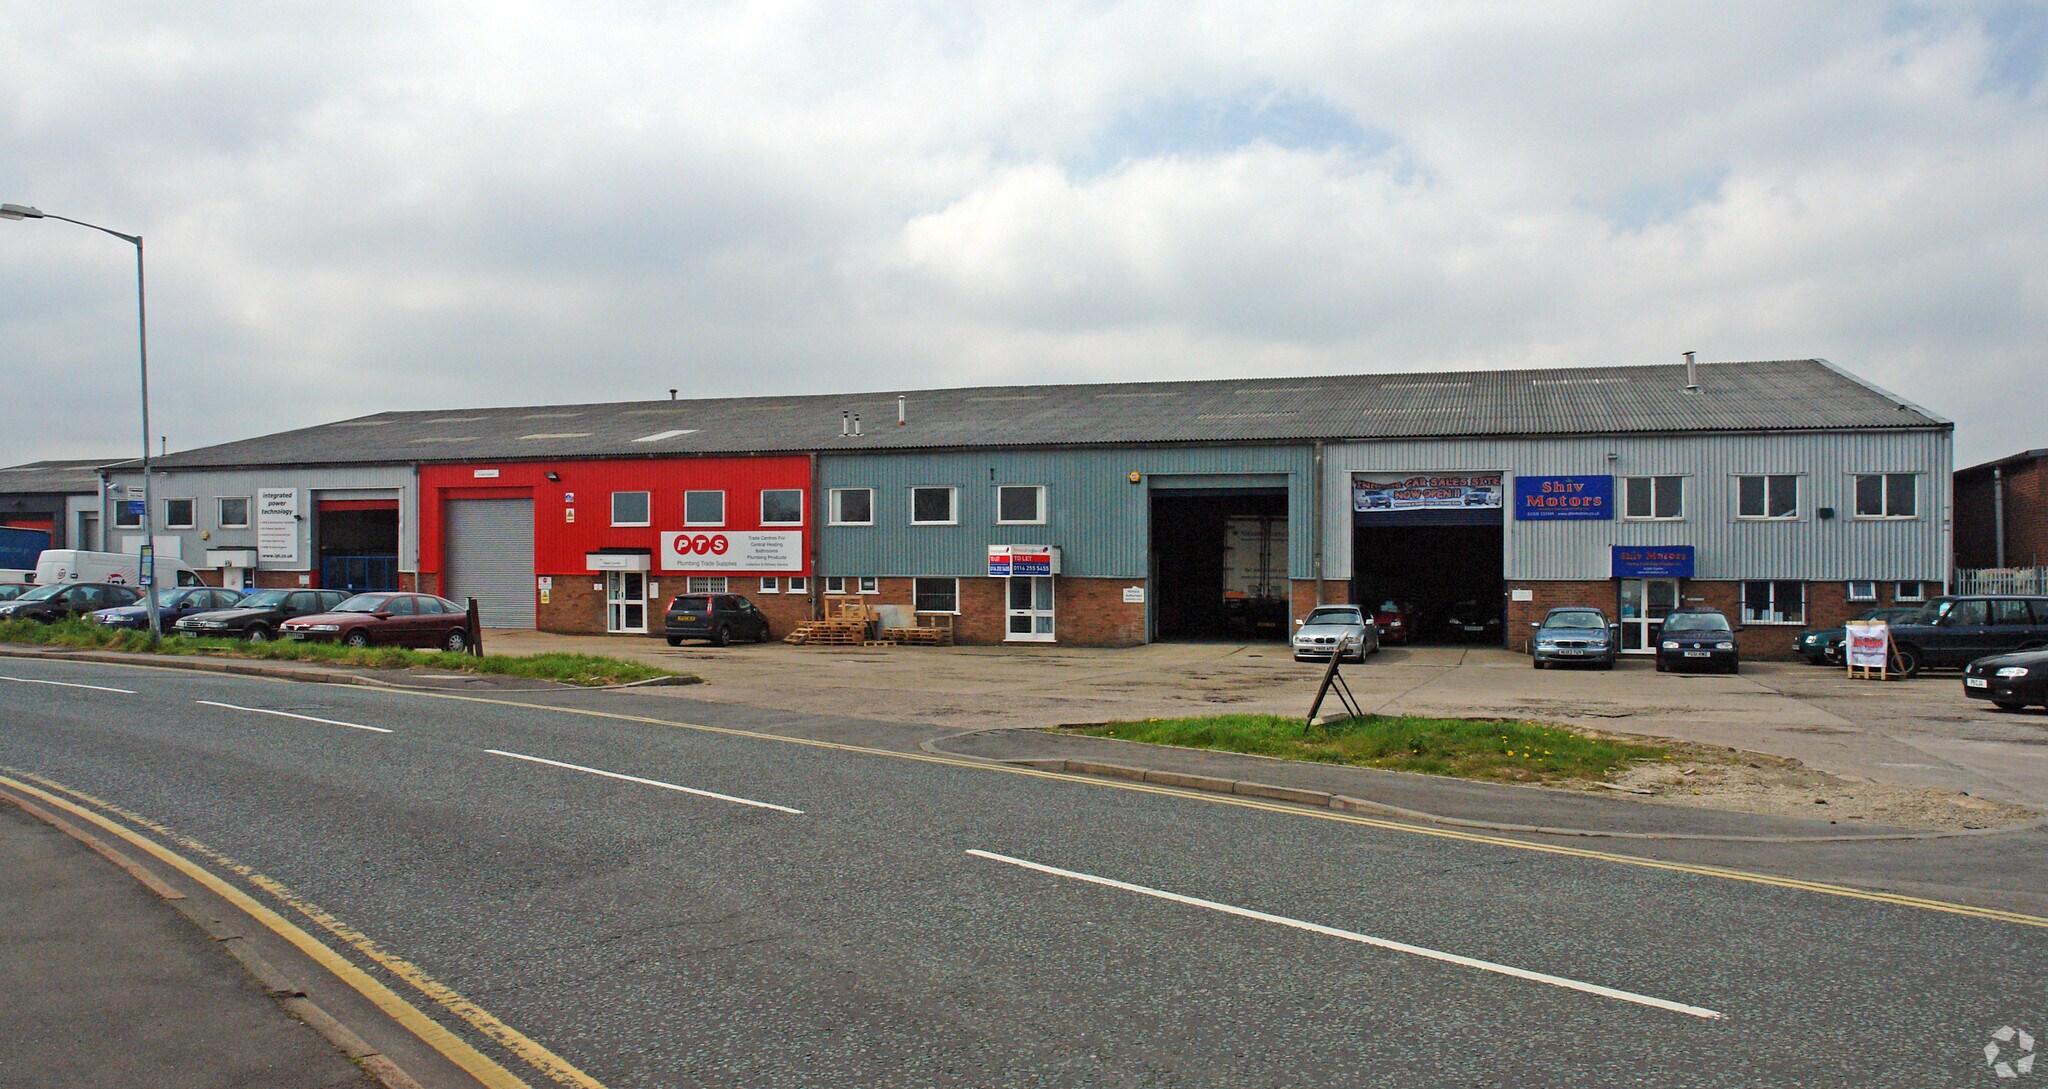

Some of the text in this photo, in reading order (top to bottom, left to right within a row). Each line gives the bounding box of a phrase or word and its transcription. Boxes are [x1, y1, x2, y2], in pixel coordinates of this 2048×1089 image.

[1404, 477, 1427, 487] CAR
[1429, 477, 1468, 487] SALES
[1470, 476, 1501, 487] SITE
[1541, 480, 1585, 493] Shiv
[1394, 490, 1421, 500] NOW
[1422, 488, 1453, 499] OPEN
[1526, 495, 1603, 507] Motors
[676, 538, 726, 552] PTS
[1645, 551, 1687, 560] Motors
